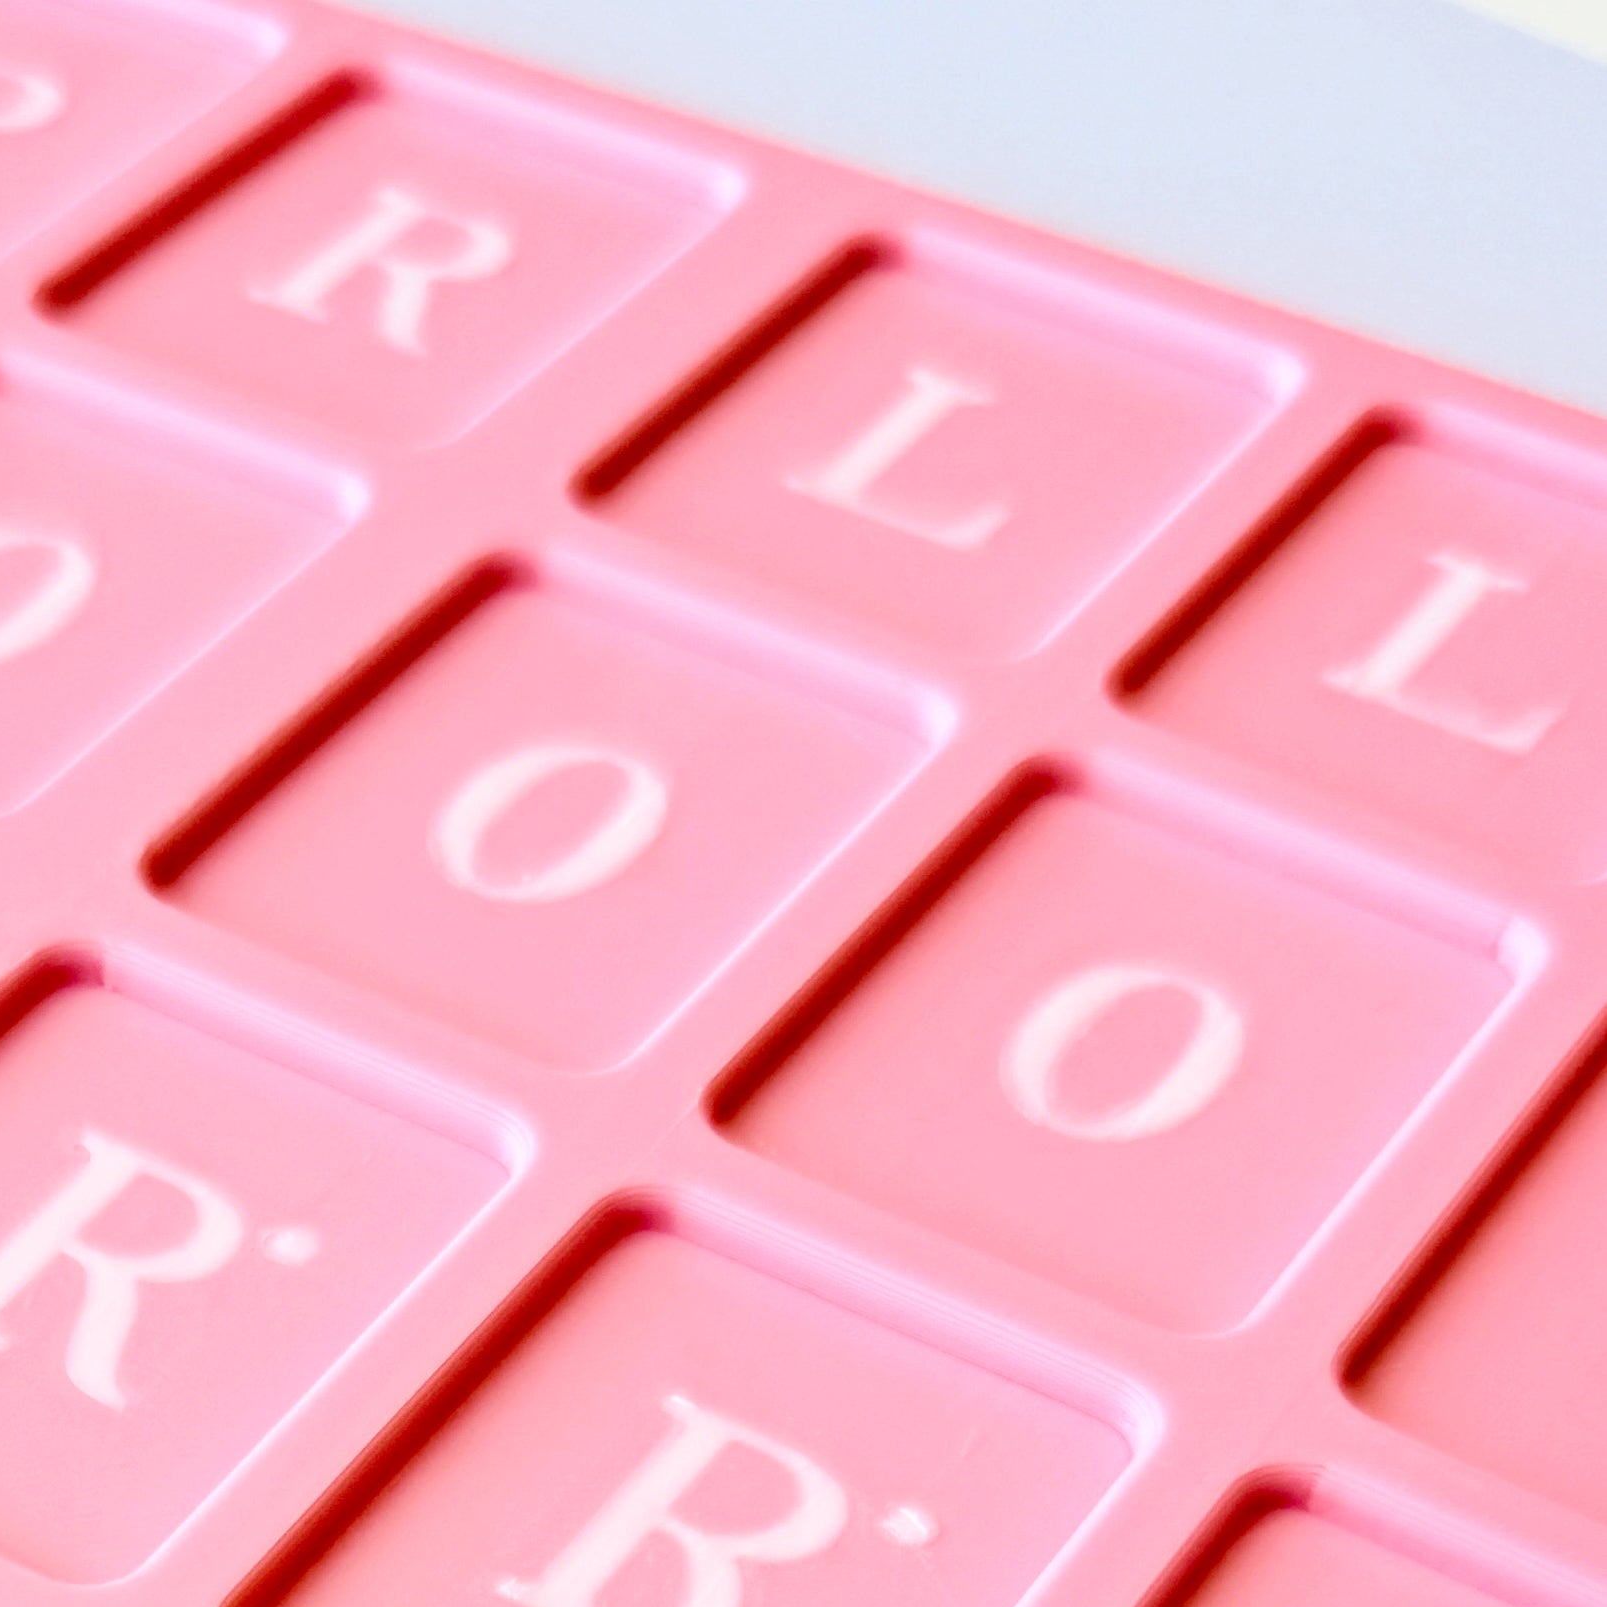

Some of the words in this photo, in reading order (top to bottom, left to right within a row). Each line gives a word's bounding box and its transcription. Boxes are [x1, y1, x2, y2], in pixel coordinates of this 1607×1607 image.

[246, 187, 511, 356] R
[781, 364, 1015, 550] L
[1320, 547, 1570, 755] L
